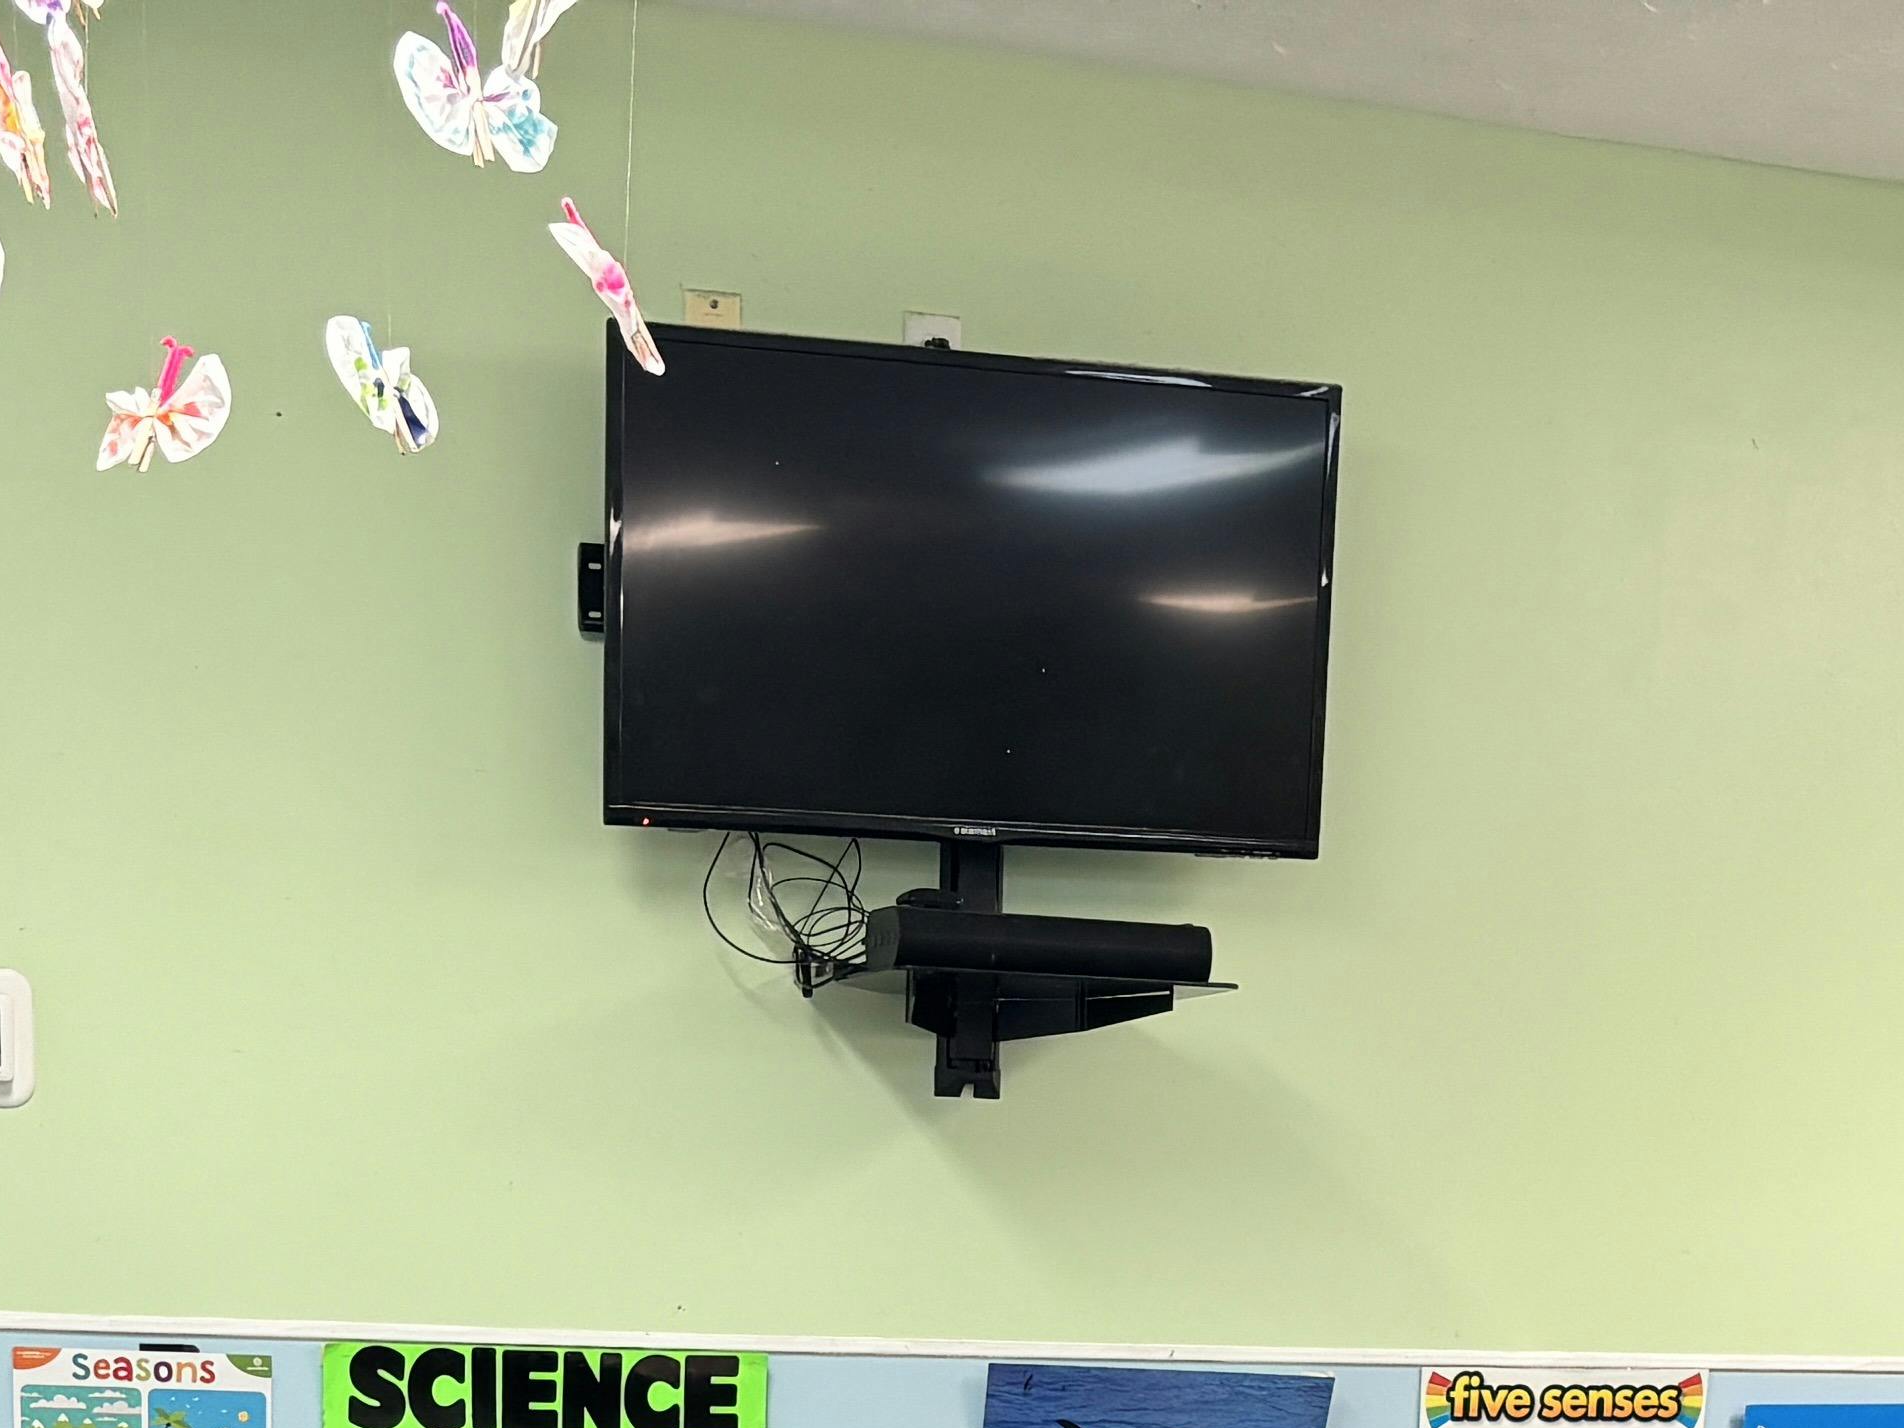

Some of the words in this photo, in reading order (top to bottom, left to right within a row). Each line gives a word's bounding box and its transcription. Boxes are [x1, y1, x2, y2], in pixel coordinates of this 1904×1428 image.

[72, 1353, 216, 1384] Seasons
[1448, 1371, 1536, 1422] five
[1539, 1384, 1683, 1423] senses
